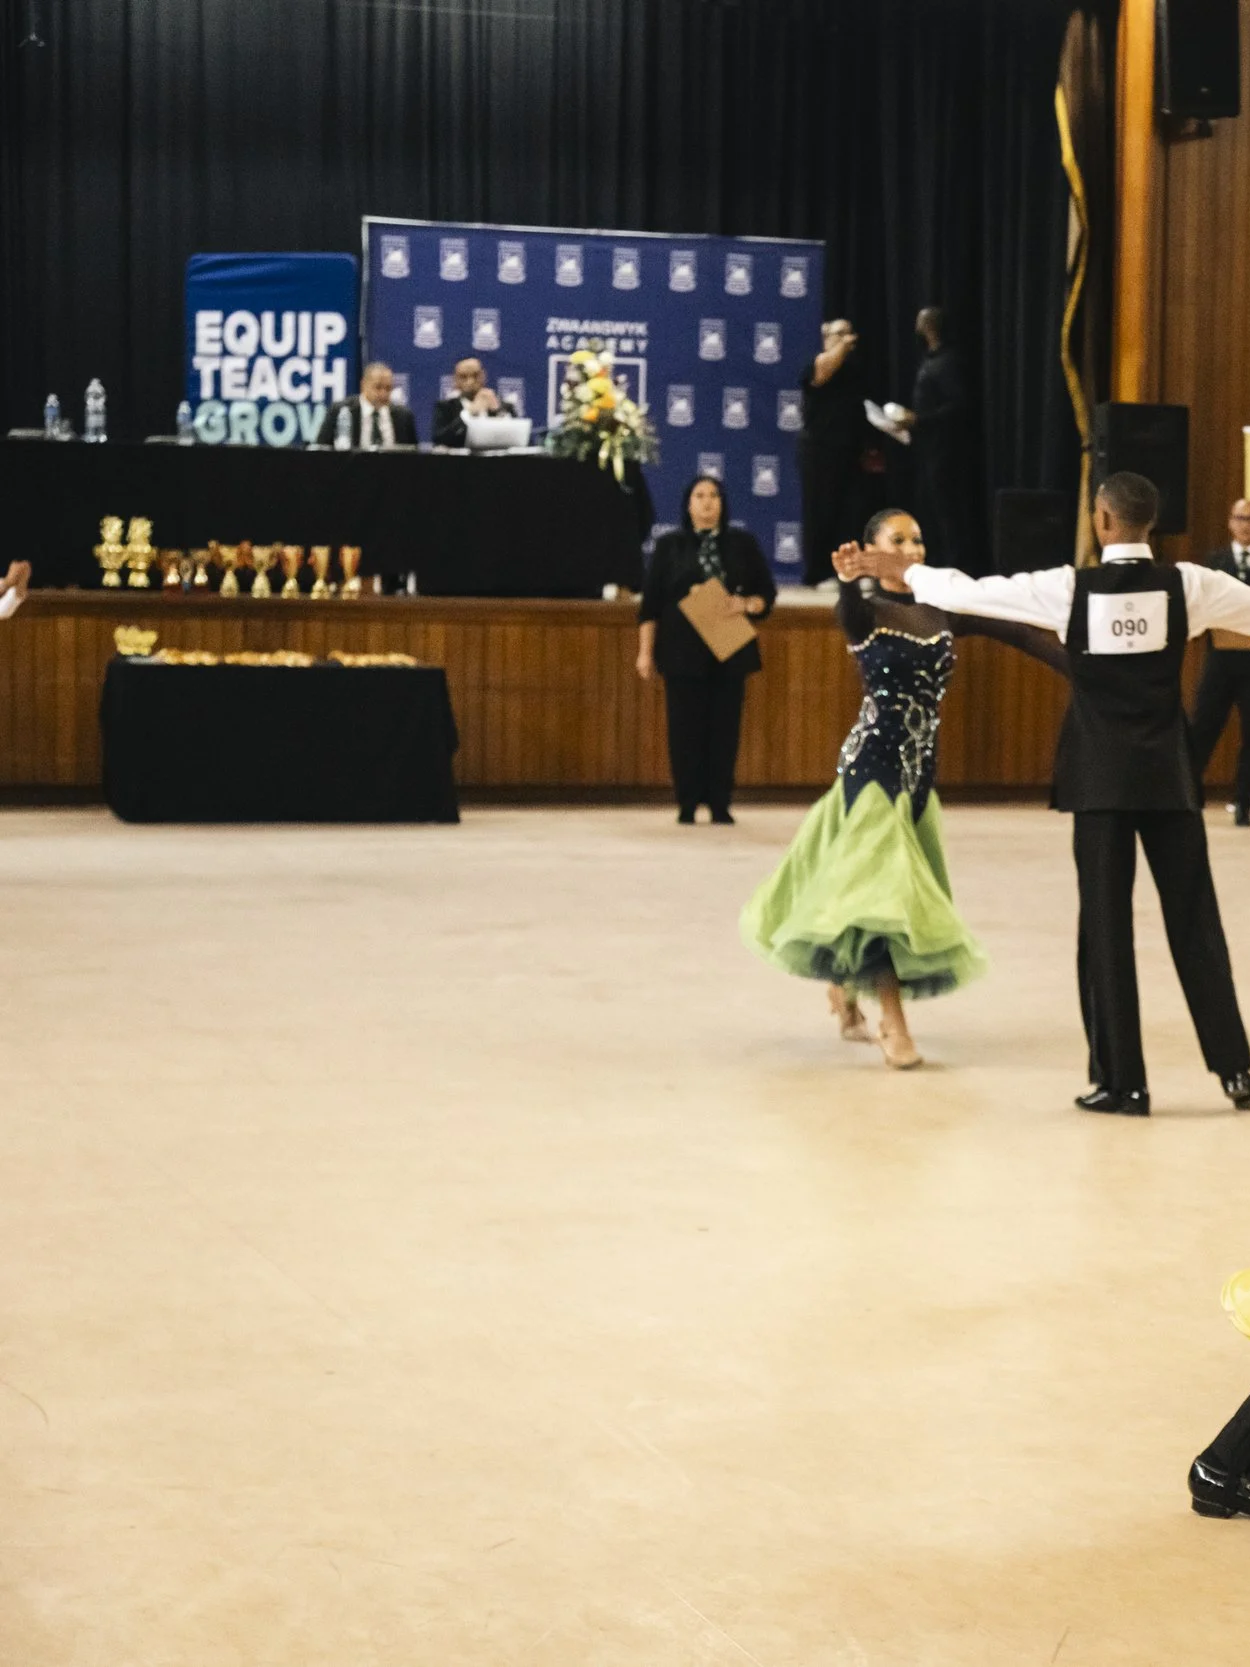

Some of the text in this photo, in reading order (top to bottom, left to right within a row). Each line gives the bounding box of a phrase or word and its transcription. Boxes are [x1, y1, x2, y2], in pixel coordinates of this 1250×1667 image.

[195, 309, 347, 358] EQUIP
[193, 355, 347, 403] TEACH
[1112, 618, 1148, 637] 090
